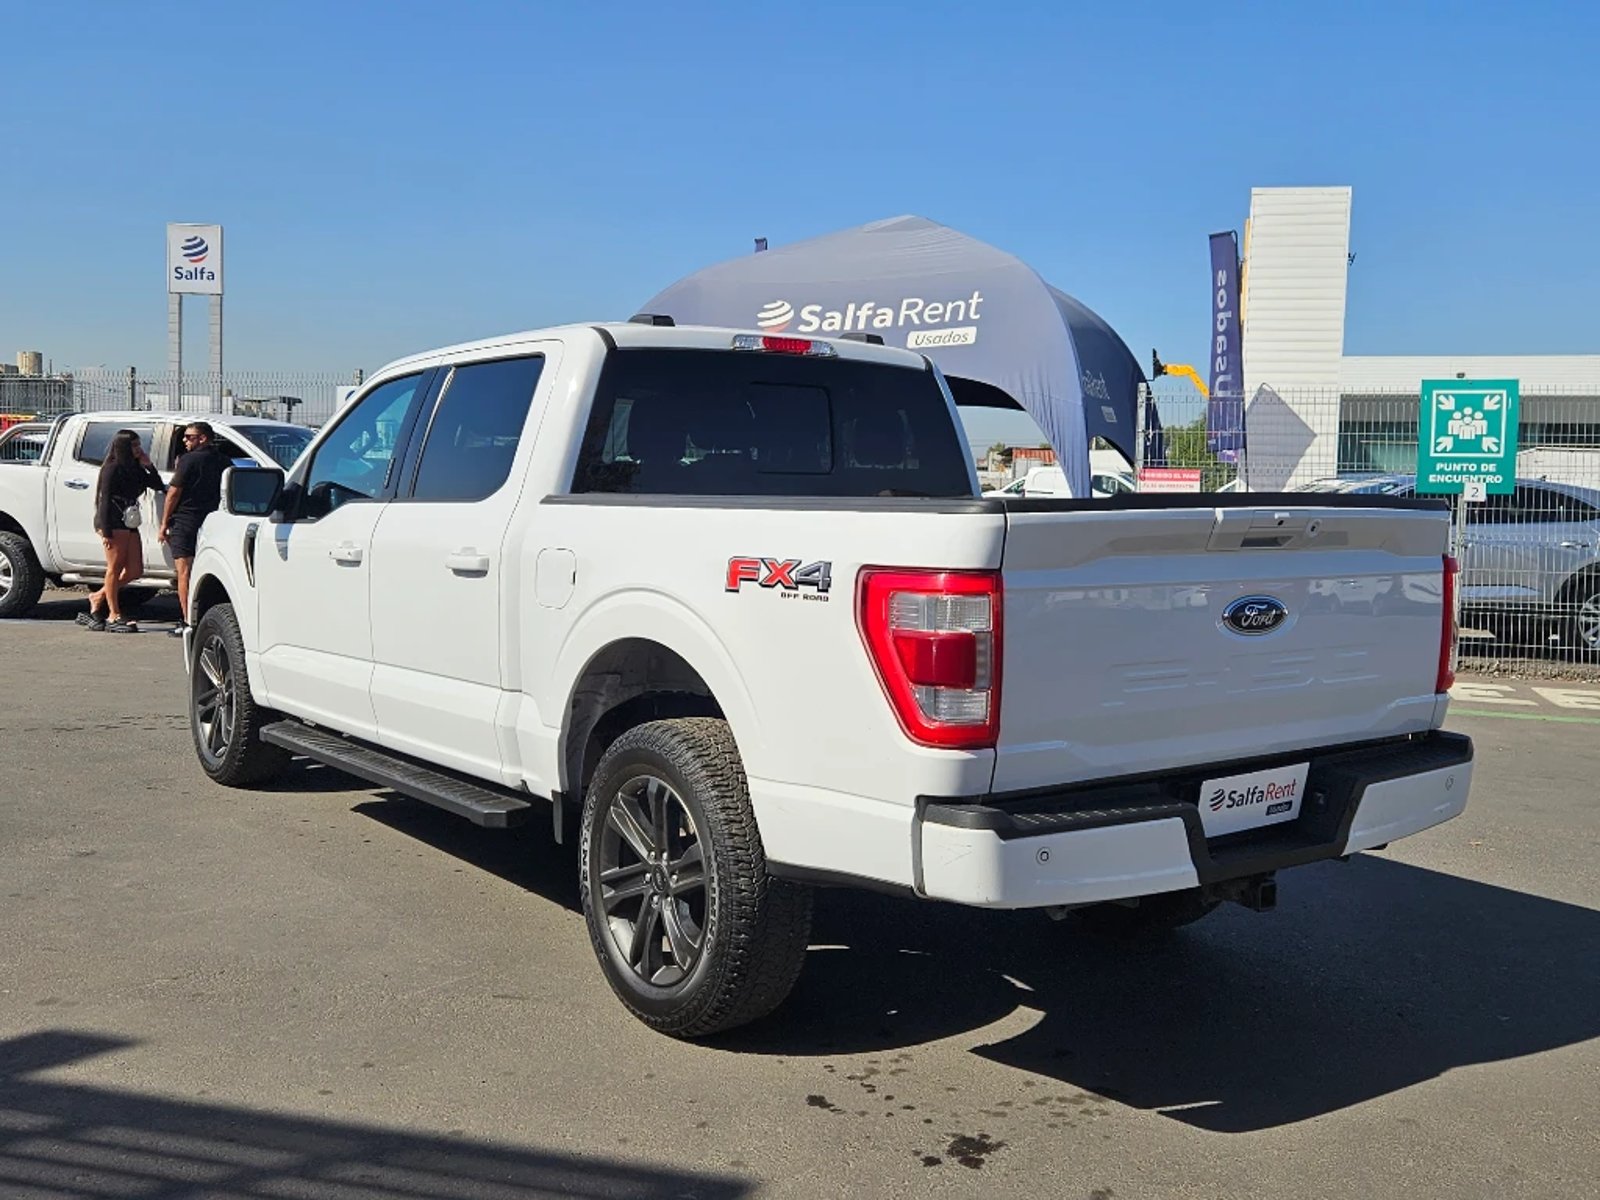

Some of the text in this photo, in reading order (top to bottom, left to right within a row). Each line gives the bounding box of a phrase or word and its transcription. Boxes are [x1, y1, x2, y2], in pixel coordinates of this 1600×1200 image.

[174, 266, 215, 281] Salfa
[797, 290, 984, 333] SalfaRent
[914, 330, 970, 347] Usados
[1435, 462, 1497, 472] PUNTO DE
[1428, 474, 1503, 484] ENCUENTRO
[1471, 486, 1479, 498] 2
[725, 556, 832, 593] FX4
[802, 593, 829, 602] ROAD
[1241, 604, 1276, 626] Ford
[1226, 779, 1297, 808] SalfaRent
